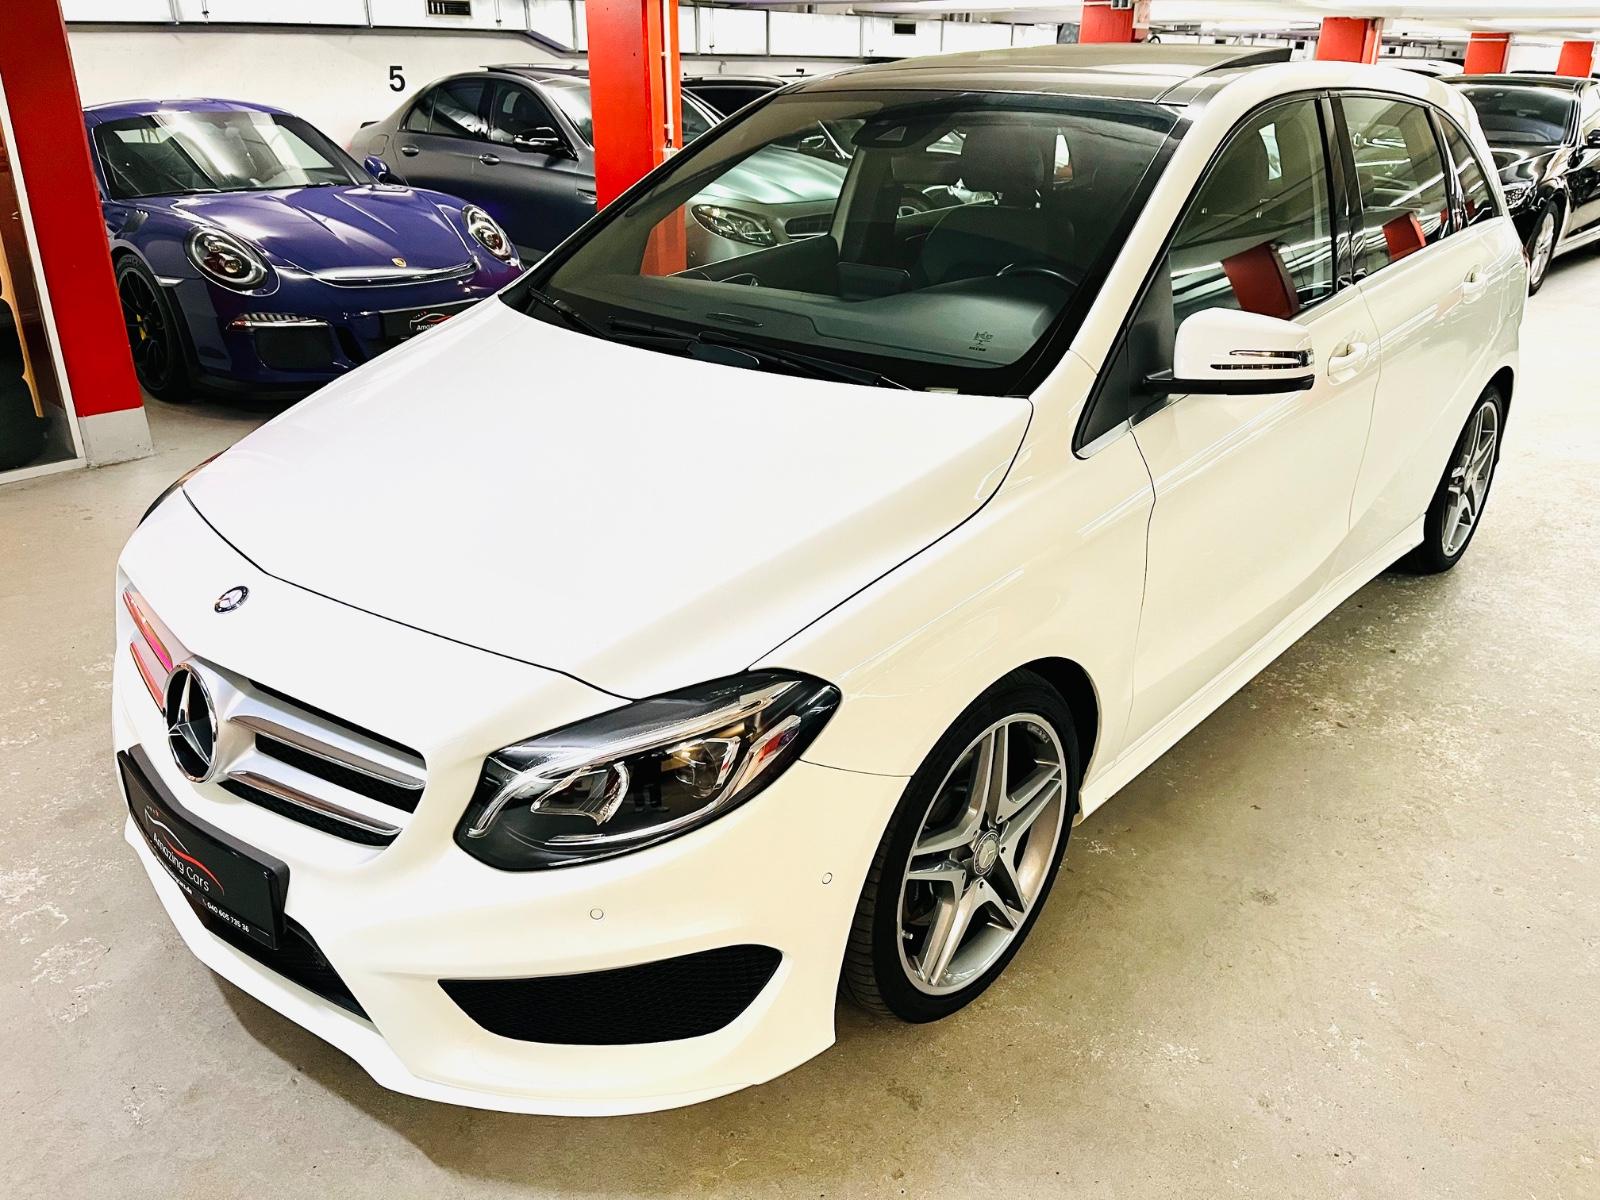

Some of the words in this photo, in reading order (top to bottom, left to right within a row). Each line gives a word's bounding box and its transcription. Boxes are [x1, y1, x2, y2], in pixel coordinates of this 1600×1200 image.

[390, 65, 406, 92] 5
[153, 832, 185, 875] Amazing
[186, 866, 210, 892] Cars
